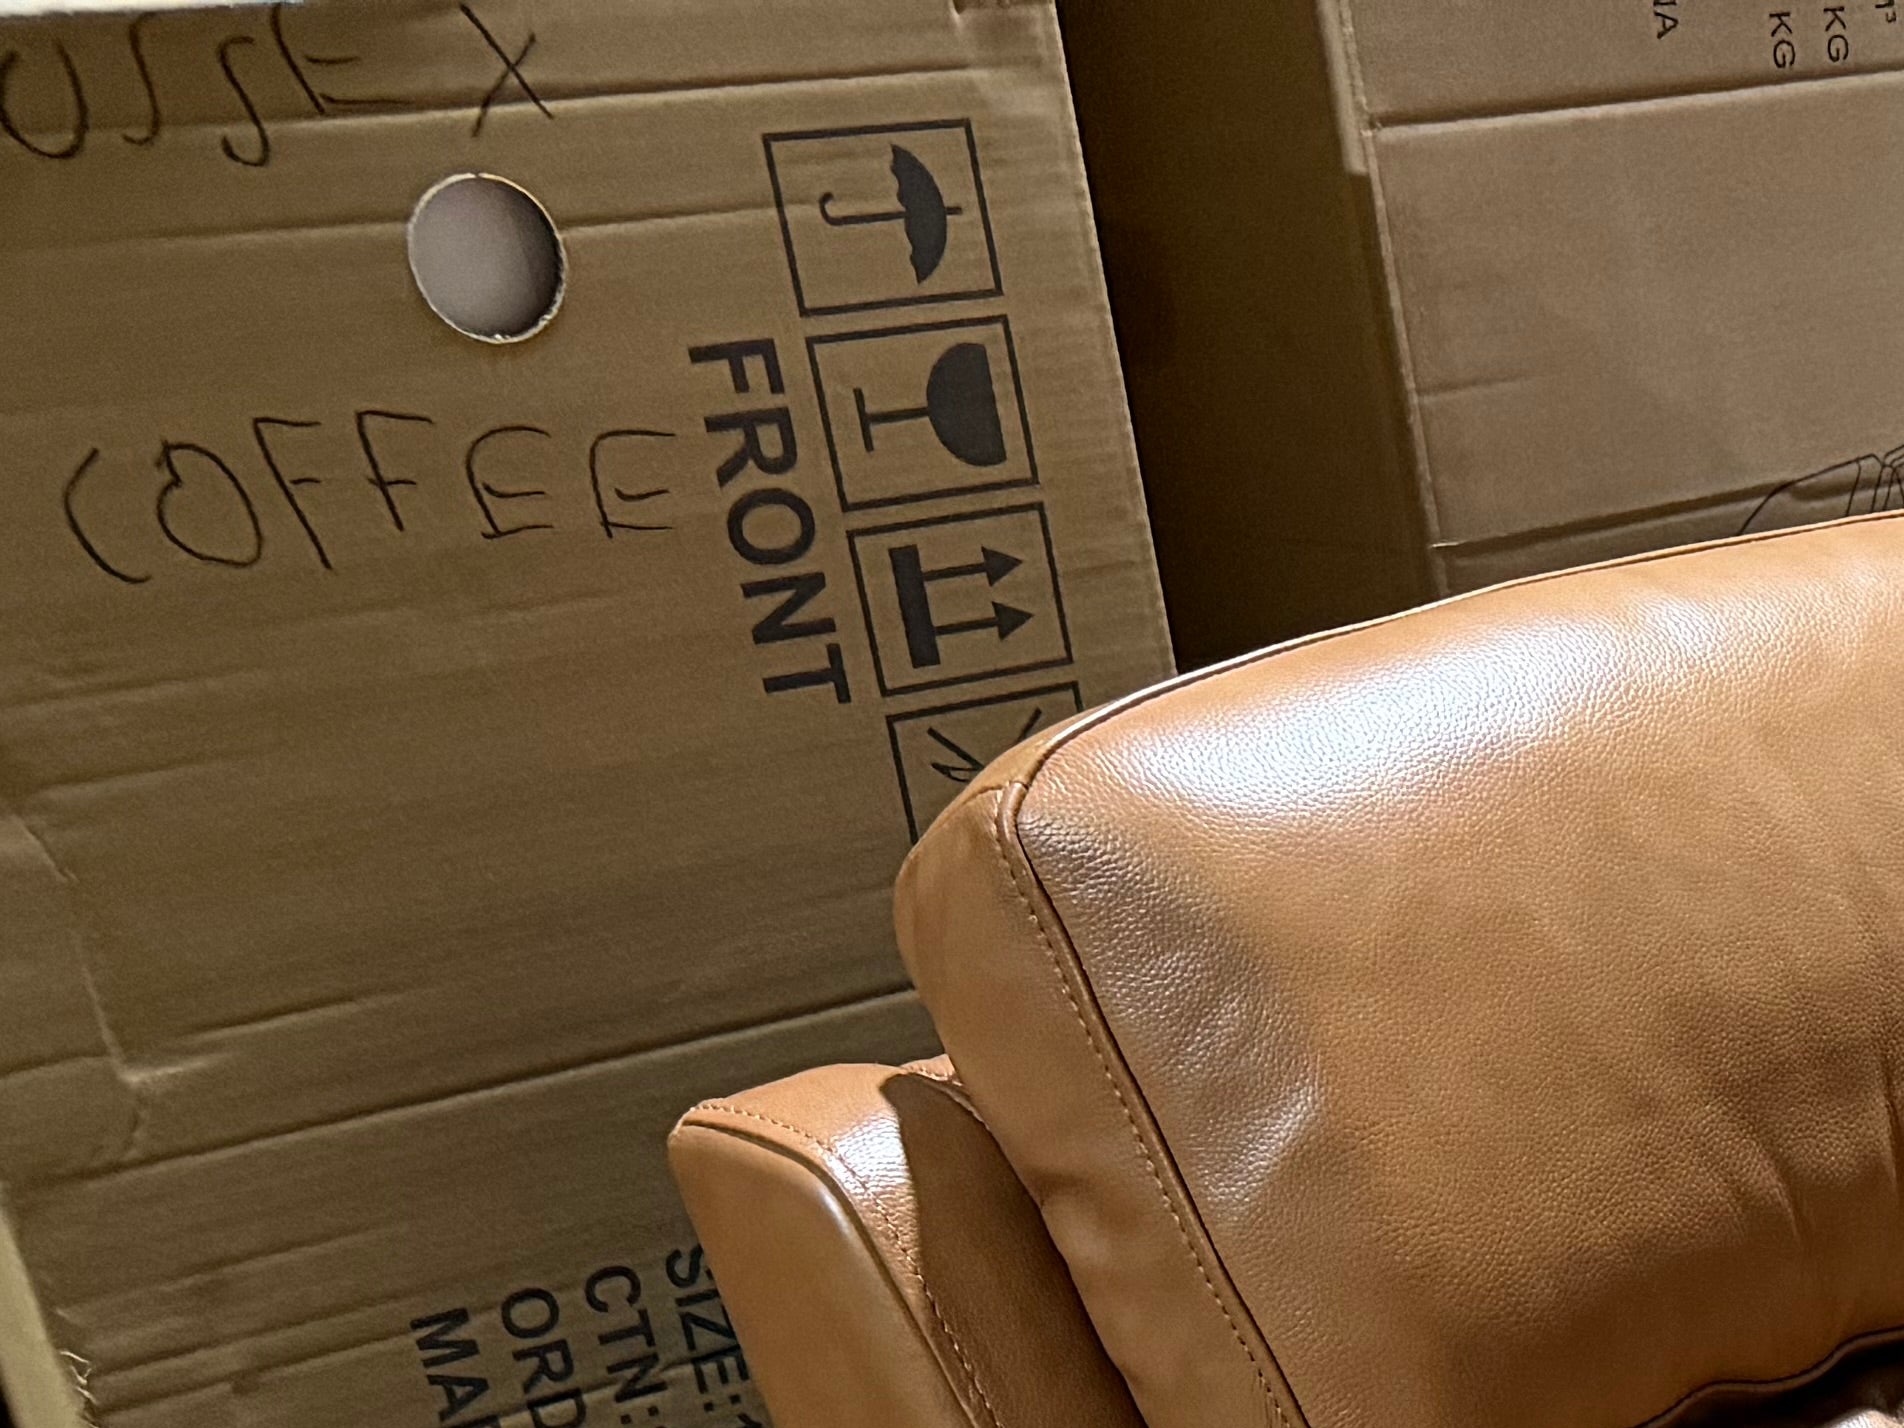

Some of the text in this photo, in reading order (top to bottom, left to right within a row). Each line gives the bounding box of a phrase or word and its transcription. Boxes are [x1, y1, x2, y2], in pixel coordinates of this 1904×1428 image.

[1768, 11, 1796, 70] KG
[1823, 6, 1850, 63] KG
[63, 410, 677, 584] COFFEE
[687, 339, 852, 706] FRONT
